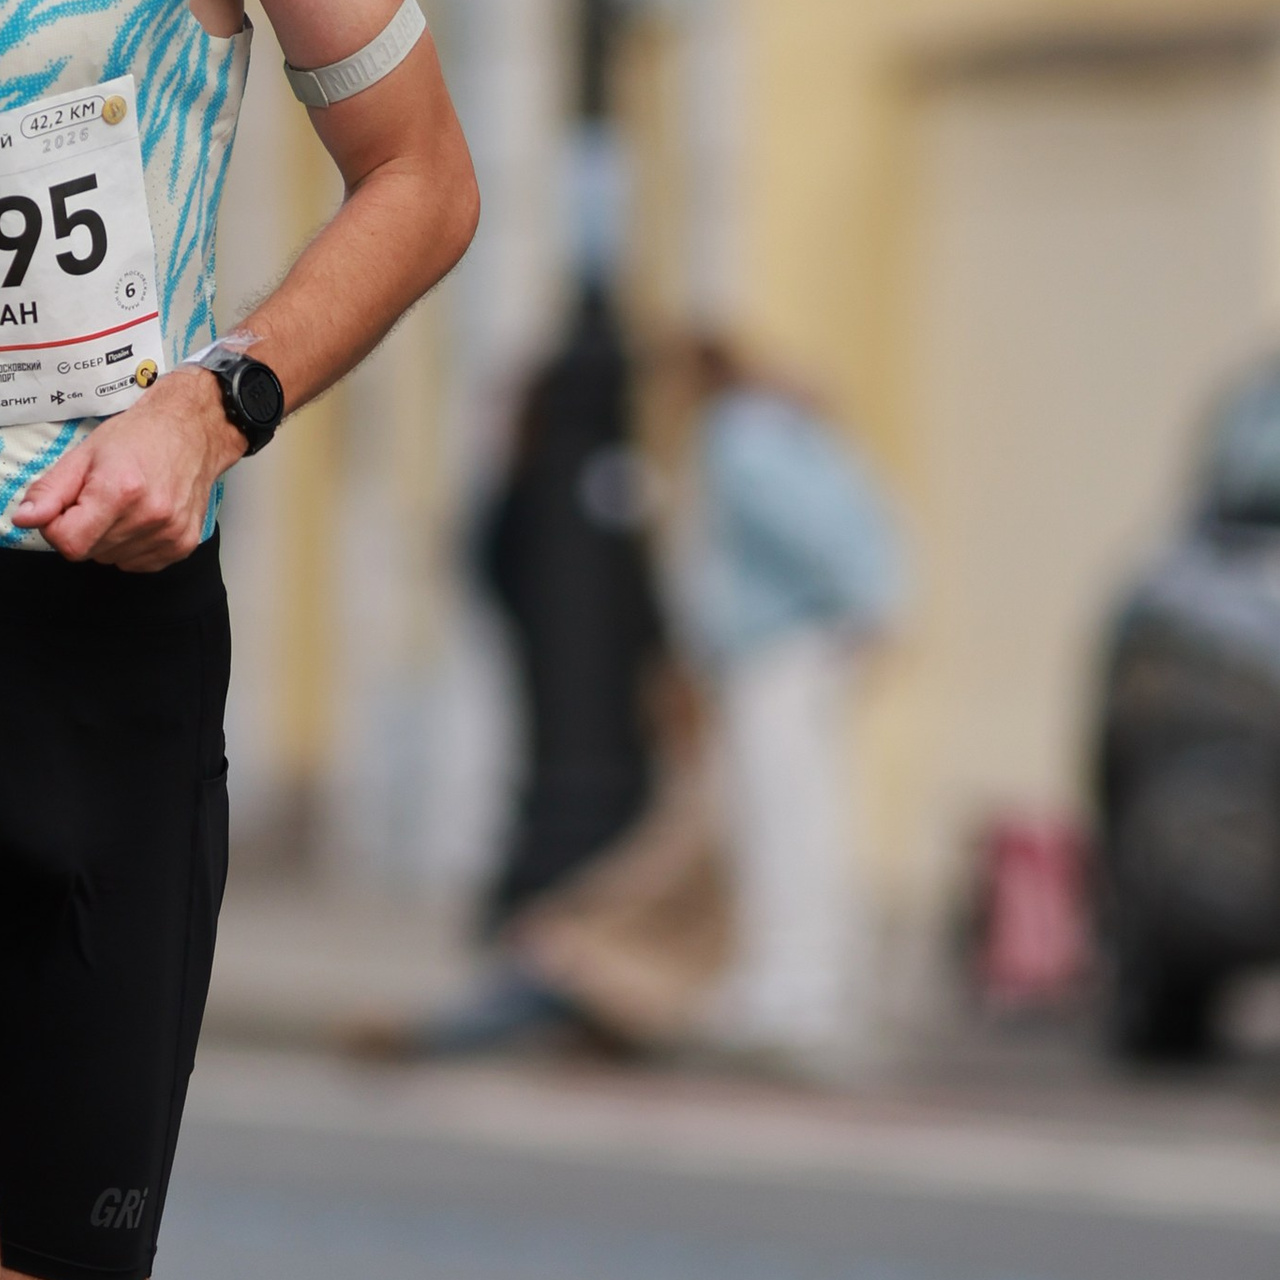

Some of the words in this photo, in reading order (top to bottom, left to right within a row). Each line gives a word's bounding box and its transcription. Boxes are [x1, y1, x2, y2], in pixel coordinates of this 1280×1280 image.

[30, 110, 63, 131] 42,2
[42, 127, 89, 153] 2026
[125, 282, 135, 298] 6
[73, 357, 104, 370] СБЕР
[99, 380, 128, 394] WINLINE
